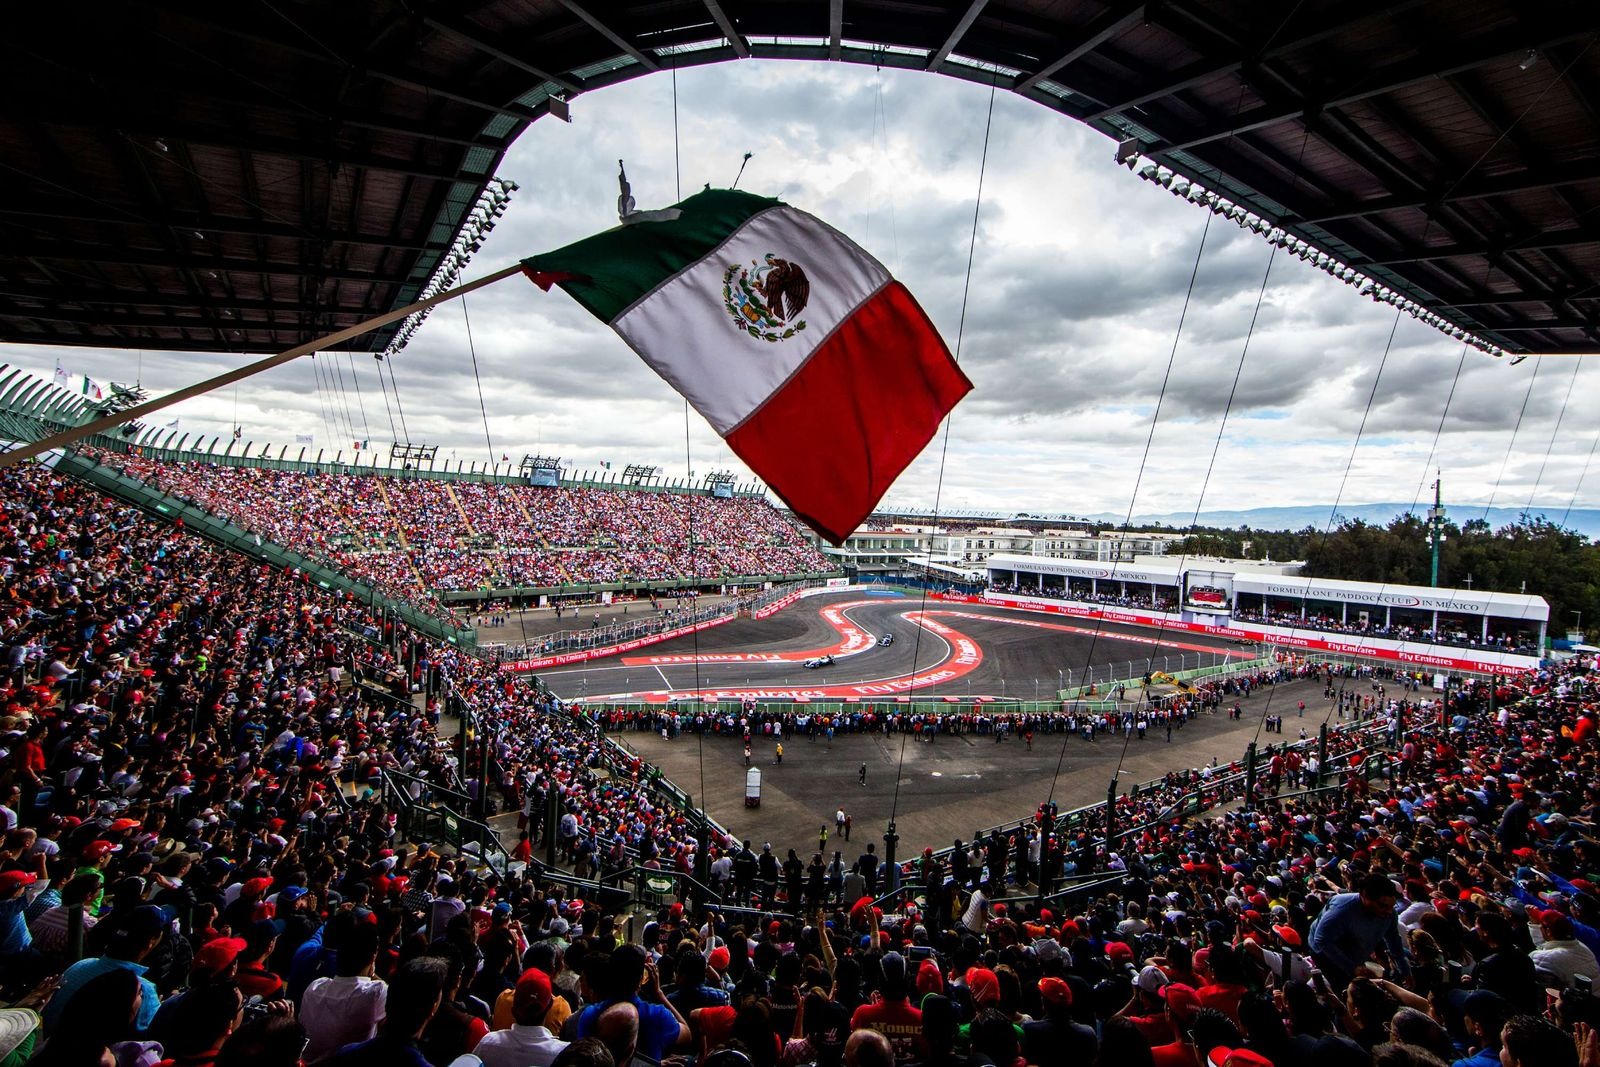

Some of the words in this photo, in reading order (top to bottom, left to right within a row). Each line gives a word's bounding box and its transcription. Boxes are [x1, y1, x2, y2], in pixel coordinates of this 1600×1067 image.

[1013, 563, 1041, 571] FORMULA
[1056, 567, 1086, 575] PADDOCK
[1267, 586, 1310, 595] FORMULA
[1336, 592, 1383, 602] PADDOCK
[1384, 597, 1412, 605] CLUB
[986, 598, 1005, 606] Emirates
[1067, 608, 1090, 616] Emirates
[1113, 613, 1137, 622] Emirates
[1152, 618, 1162, 626] Fly
[1216, 627, 1245, 637] Emirates
[1263, 634, 1276, 642] Fly
[1276, 635, 1308, 646] Emirates
[1327, 642, 1340, 651] Fly
[1342, 644, 1377, 655] Emirates
[566, 653, 588, 661] Emirates
[1399, 652, 1414, 661] Fly
[1415, 654, 1453, 666] Emirates
[530, 659, 554, 668] Emirates
[1478, 663, 1494, 673] Fly
[852, 685, 895, 694] Fly
[891, 670, 956, 688] Emirates
[715, 690, 826, 699] Emirates
